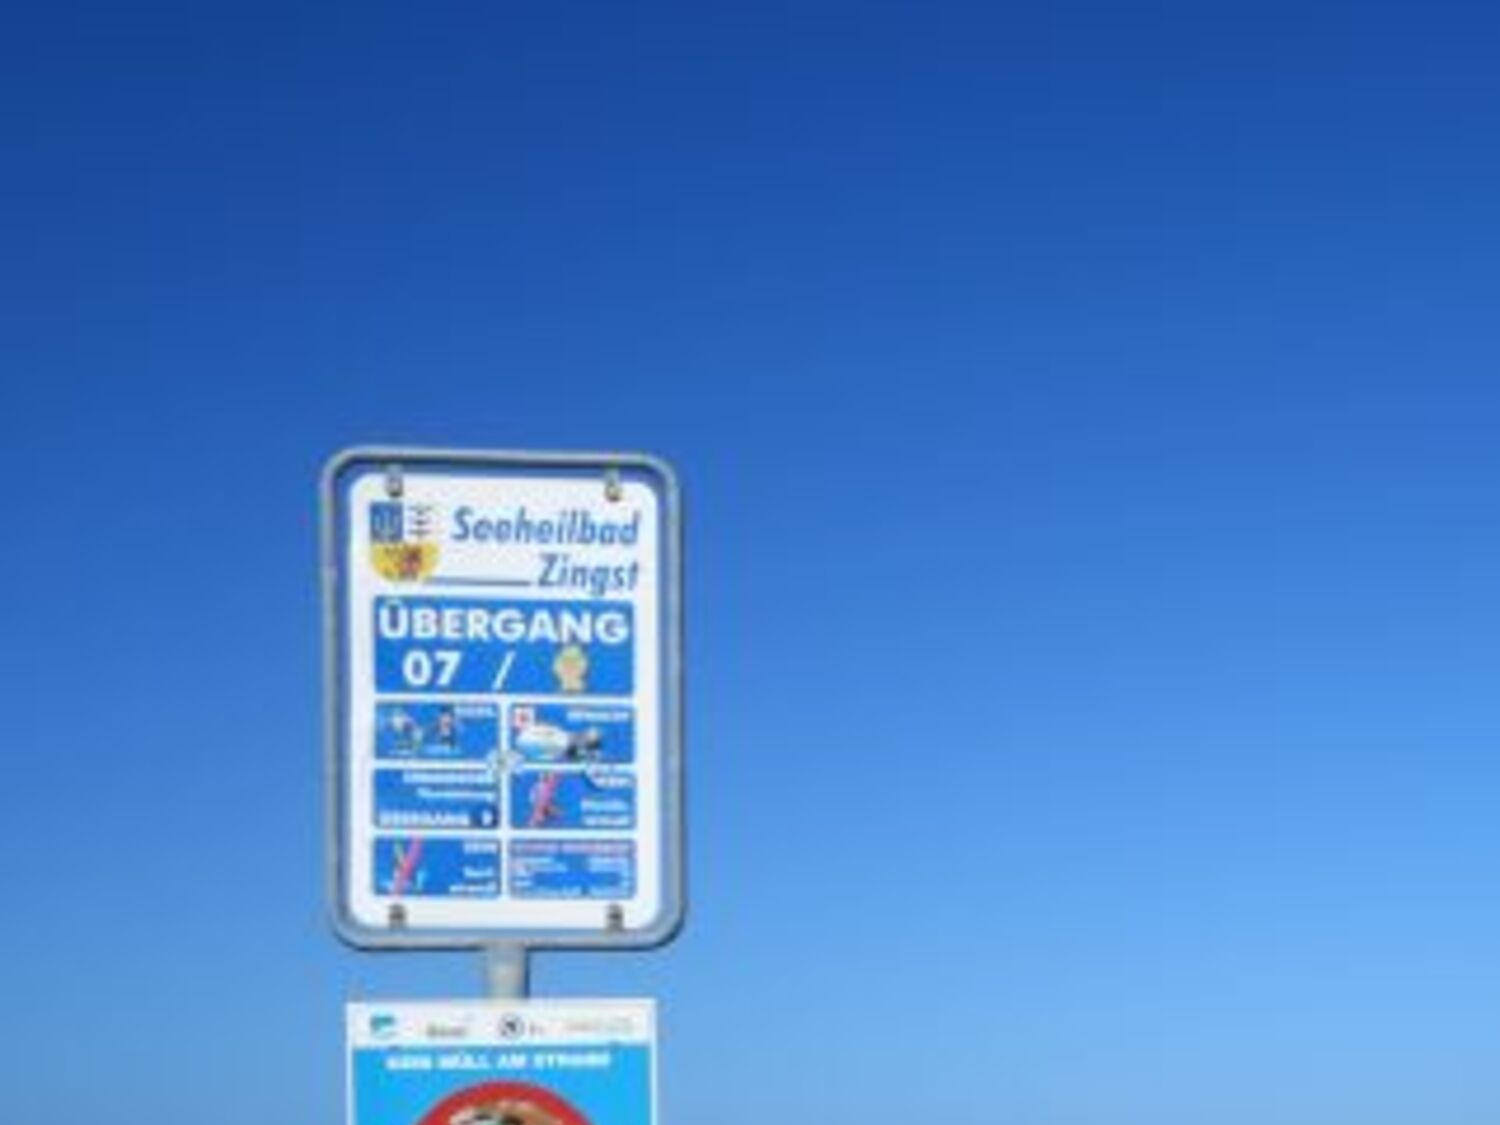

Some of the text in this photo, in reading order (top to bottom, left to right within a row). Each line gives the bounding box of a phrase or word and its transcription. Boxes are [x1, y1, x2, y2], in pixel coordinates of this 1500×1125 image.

[453, 507, 641, 545] Seeheilbad
[537, 553, 640, 596] Zingst
[378, 601, 629, 644] ÜBERGANG
[403, 650, 515, 690] 07 /
